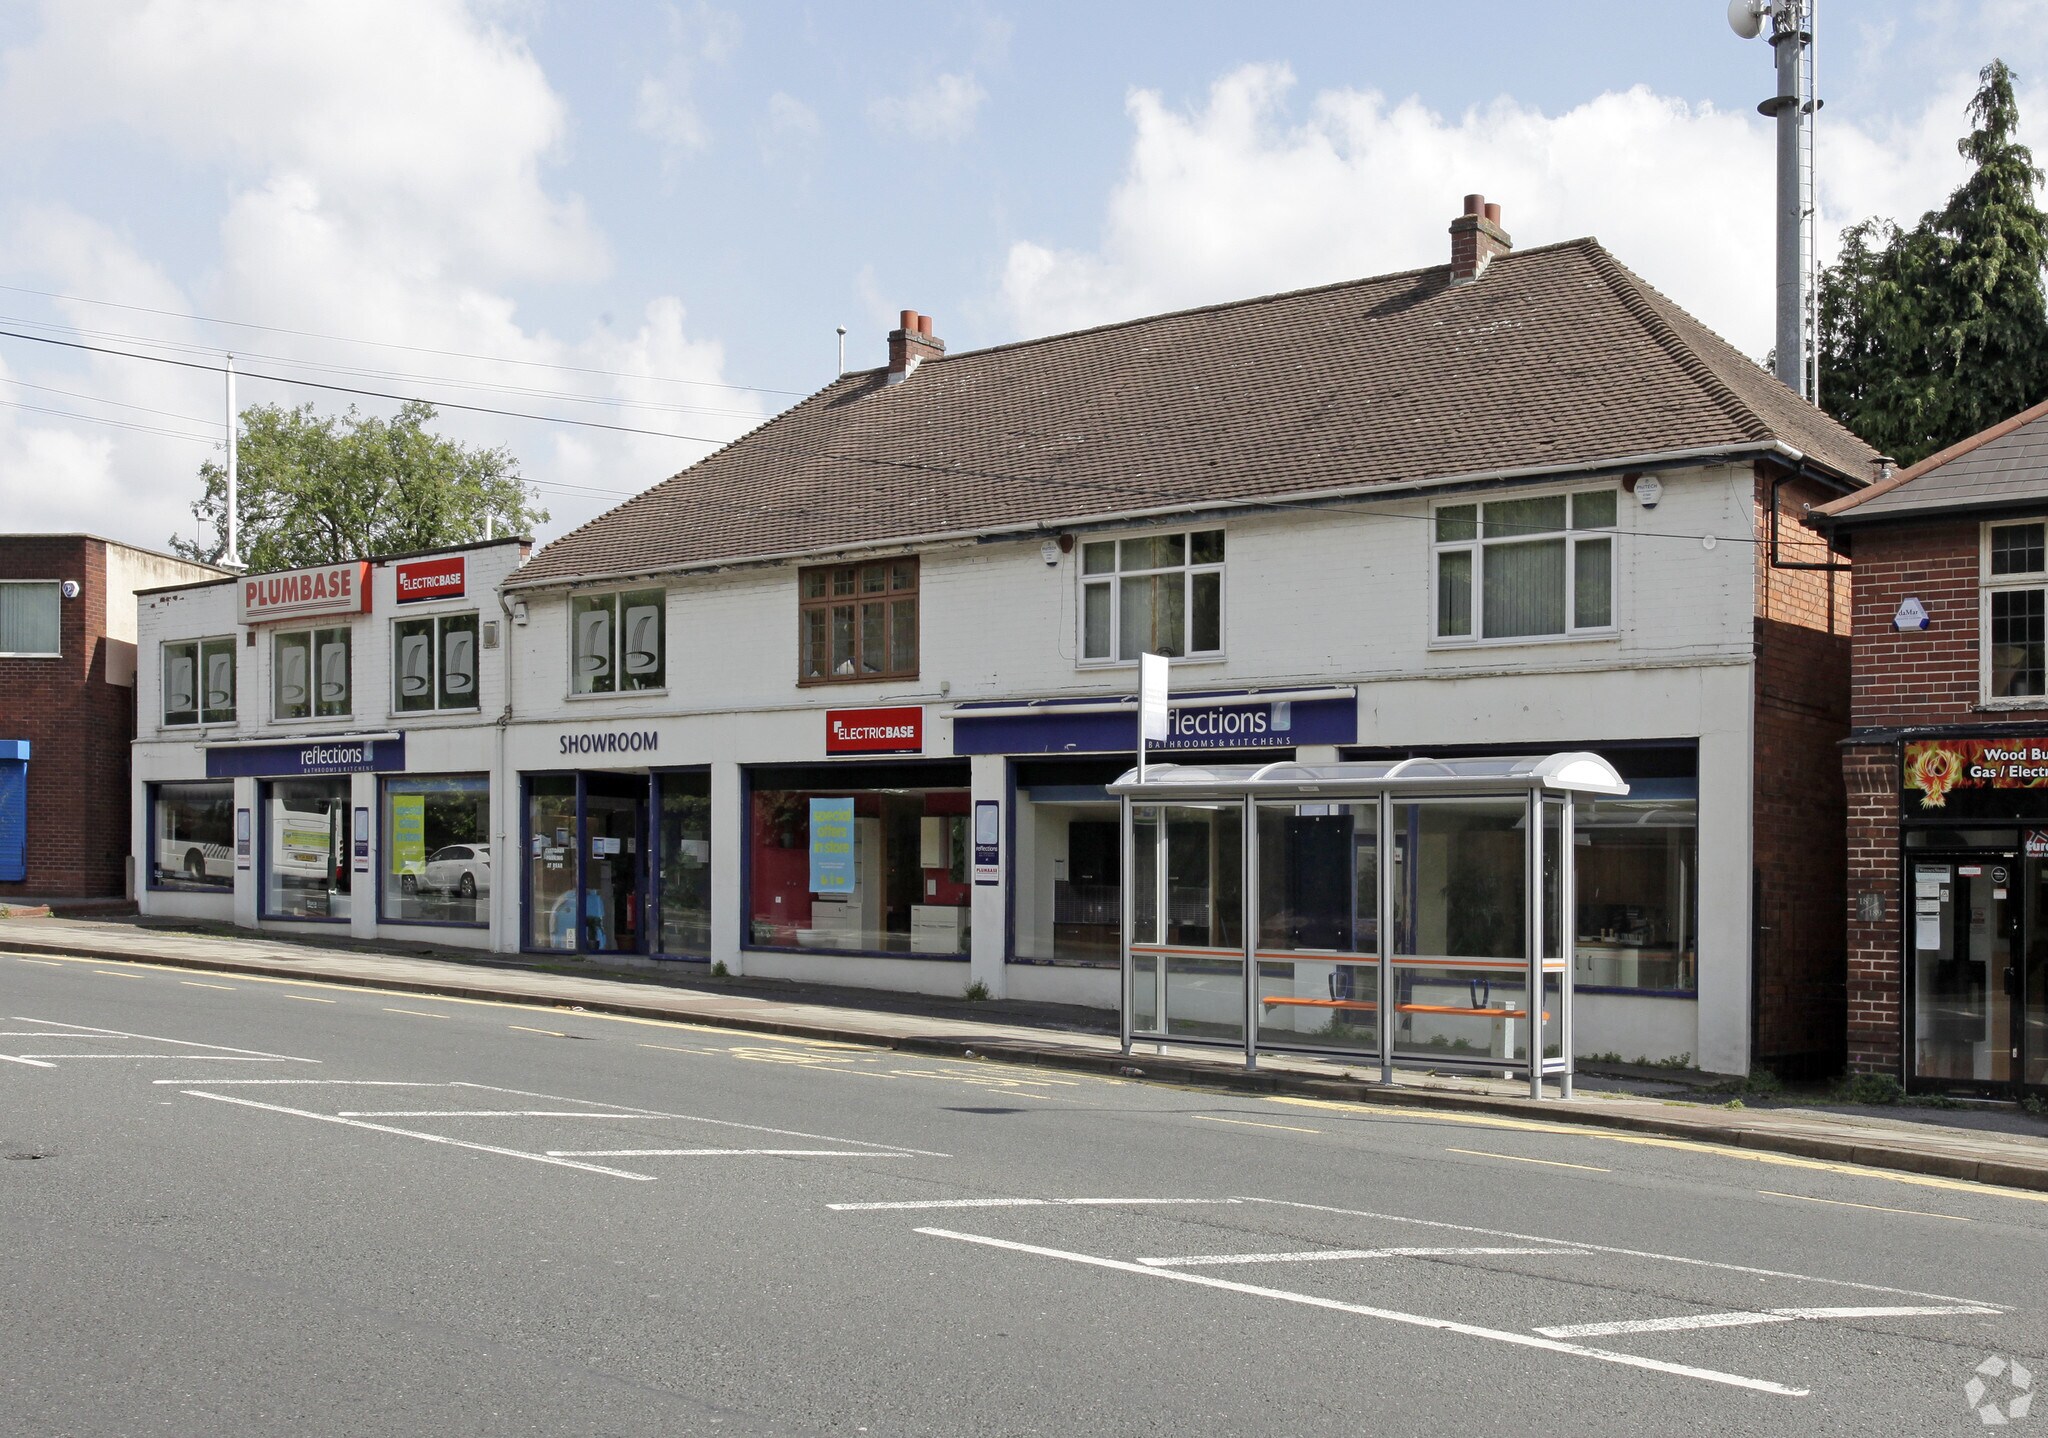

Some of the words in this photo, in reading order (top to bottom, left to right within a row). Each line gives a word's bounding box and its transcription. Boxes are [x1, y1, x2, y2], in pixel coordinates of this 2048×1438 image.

[245, 569, 352, 608] PLUMBASE
[403, 573, 461, 590] ELECTRICBASE
[1166, 707, 1267, 735] flections
[838, 726, 914, 740] ELECTRICBASE
[560, 731, 658, 754] SHOWROOM
[1148, 739, 1214, 749] BATHROOMS
[1229, 737, 1291, 747] KITCHENS
[301, 745, 362, 765] reflections
[1984, 748, 2026, 760] Wood
[1970, 766, 1997, 778] Gas
[814, 808, 851, 822] special
[817, 825, 847, 838] offers
